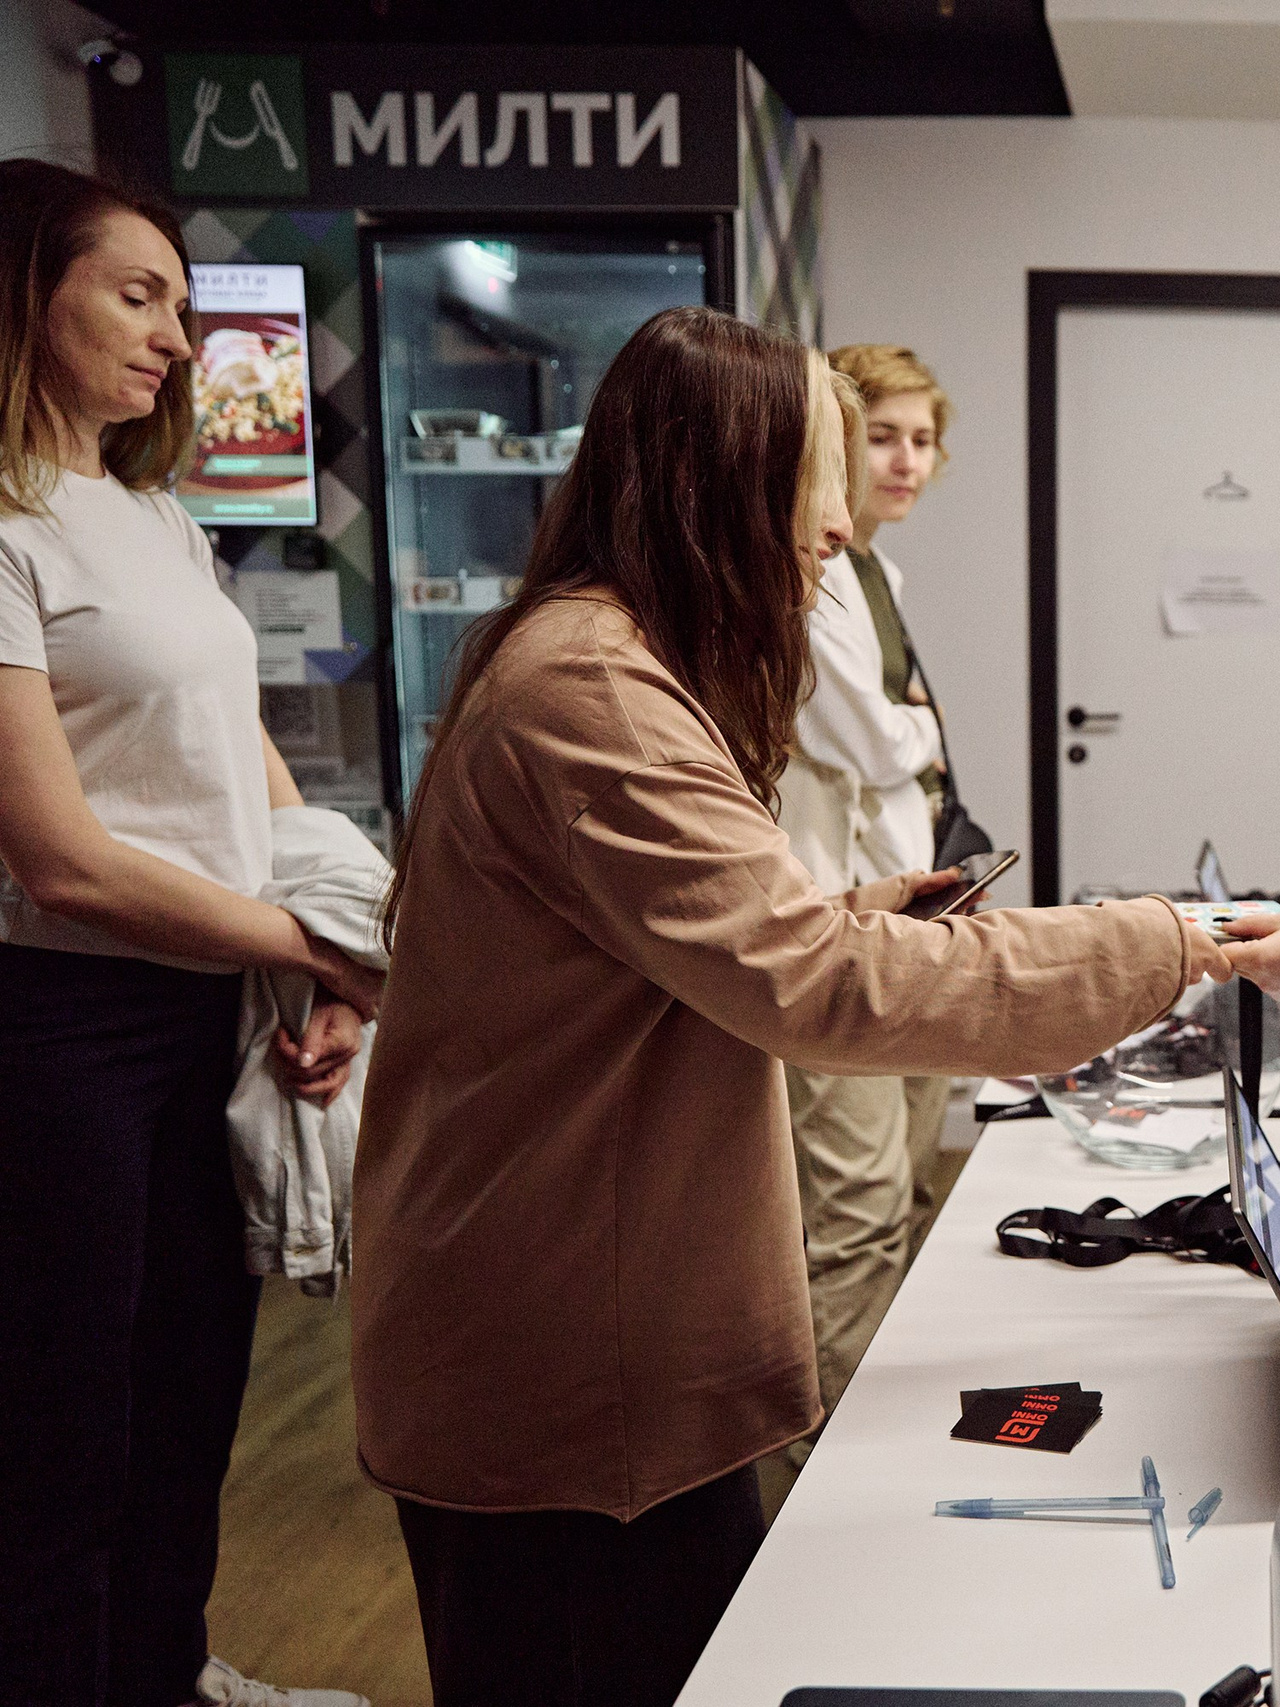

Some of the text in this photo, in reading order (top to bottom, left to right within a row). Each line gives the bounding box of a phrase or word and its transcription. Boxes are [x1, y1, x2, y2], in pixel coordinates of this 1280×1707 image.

[331, 91, 682, 168] МИЛТИ
[1022, 1400, 1058, 1411] OMNI
[1011, 1410, 1048, 1421] OMNI
